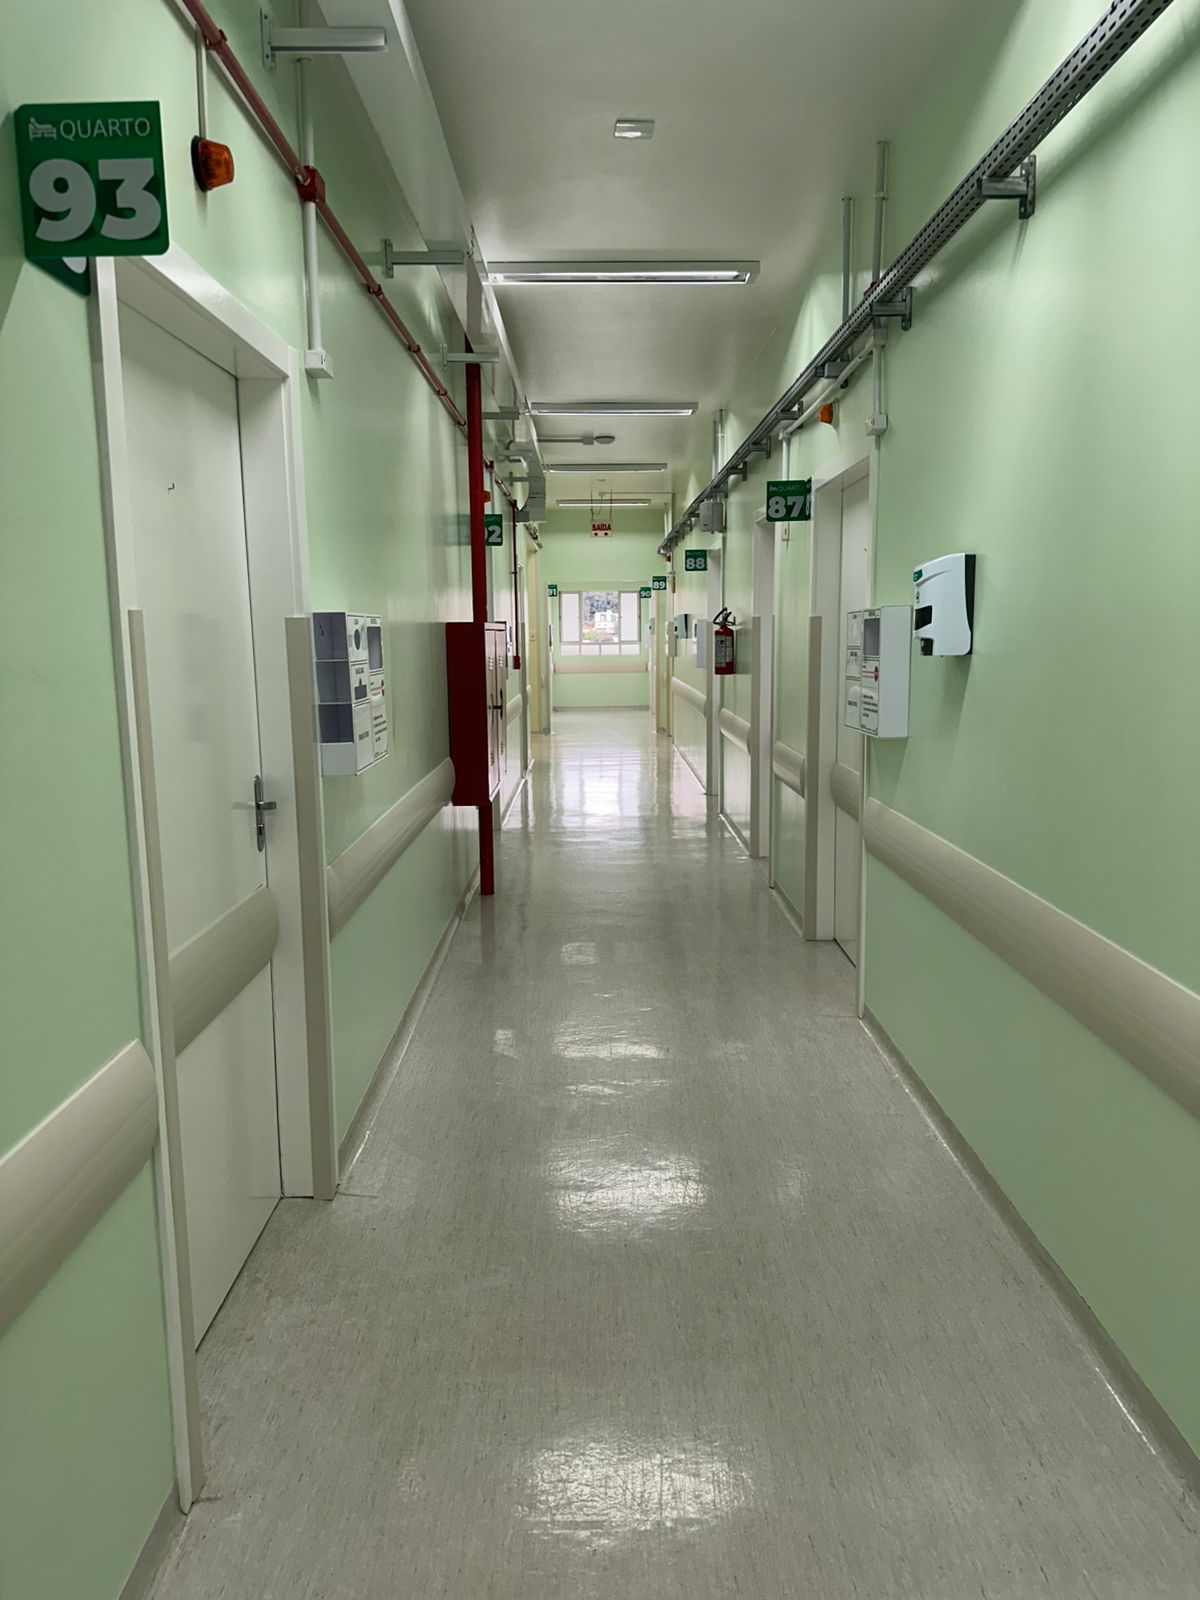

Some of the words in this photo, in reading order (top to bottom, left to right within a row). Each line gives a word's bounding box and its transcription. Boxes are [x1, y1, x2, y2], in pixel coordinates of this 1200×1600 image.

[60, 117, 151, 141] QUARTO
[29, 158, 162, 242] 93
[768, 496, 804, 518] 87
[687, 558, 705, 570] 88
[653, 581, 666, 589] 89
